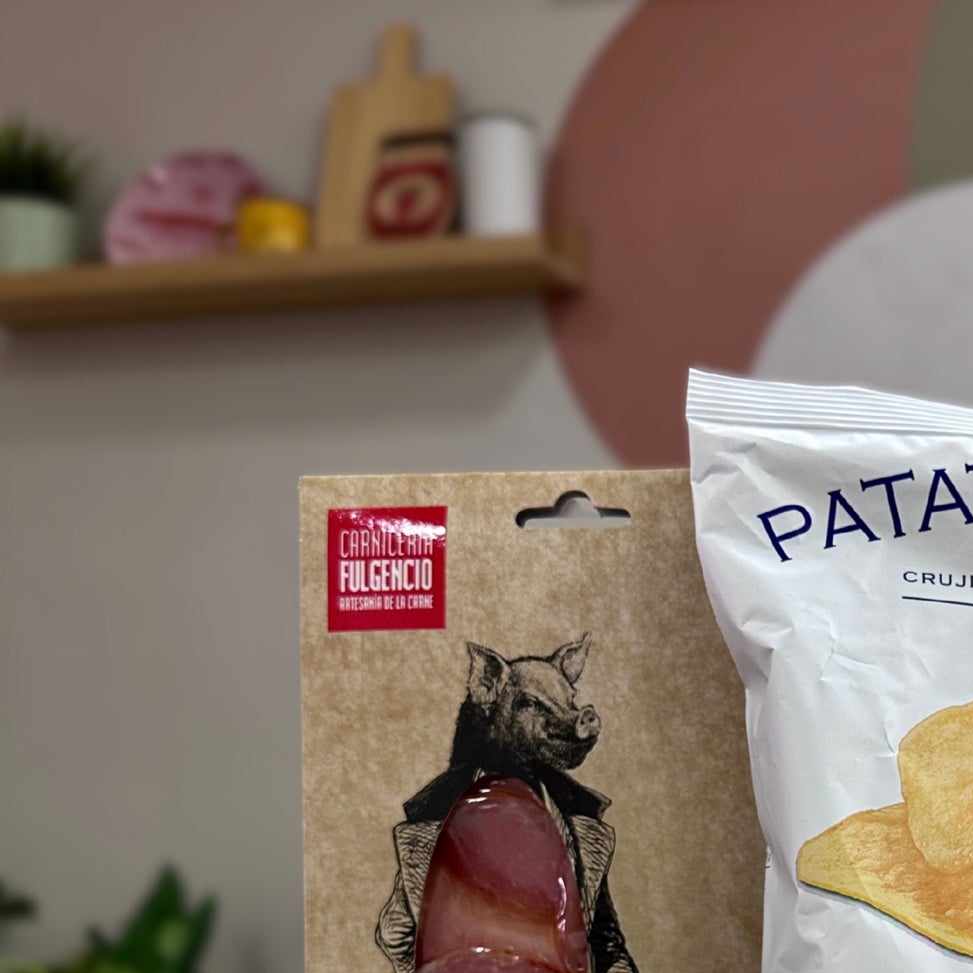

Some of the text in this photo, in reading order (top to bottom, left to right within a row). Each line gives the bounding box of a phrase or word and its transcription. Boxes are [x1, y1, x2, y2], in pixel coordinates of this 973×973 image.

[340, 559, 433, 593] FULGENCIO
[383, 596, 394, 610] DE
[396, 595, 406, 610] LA
[407, 594, 434, 609] CARNE
